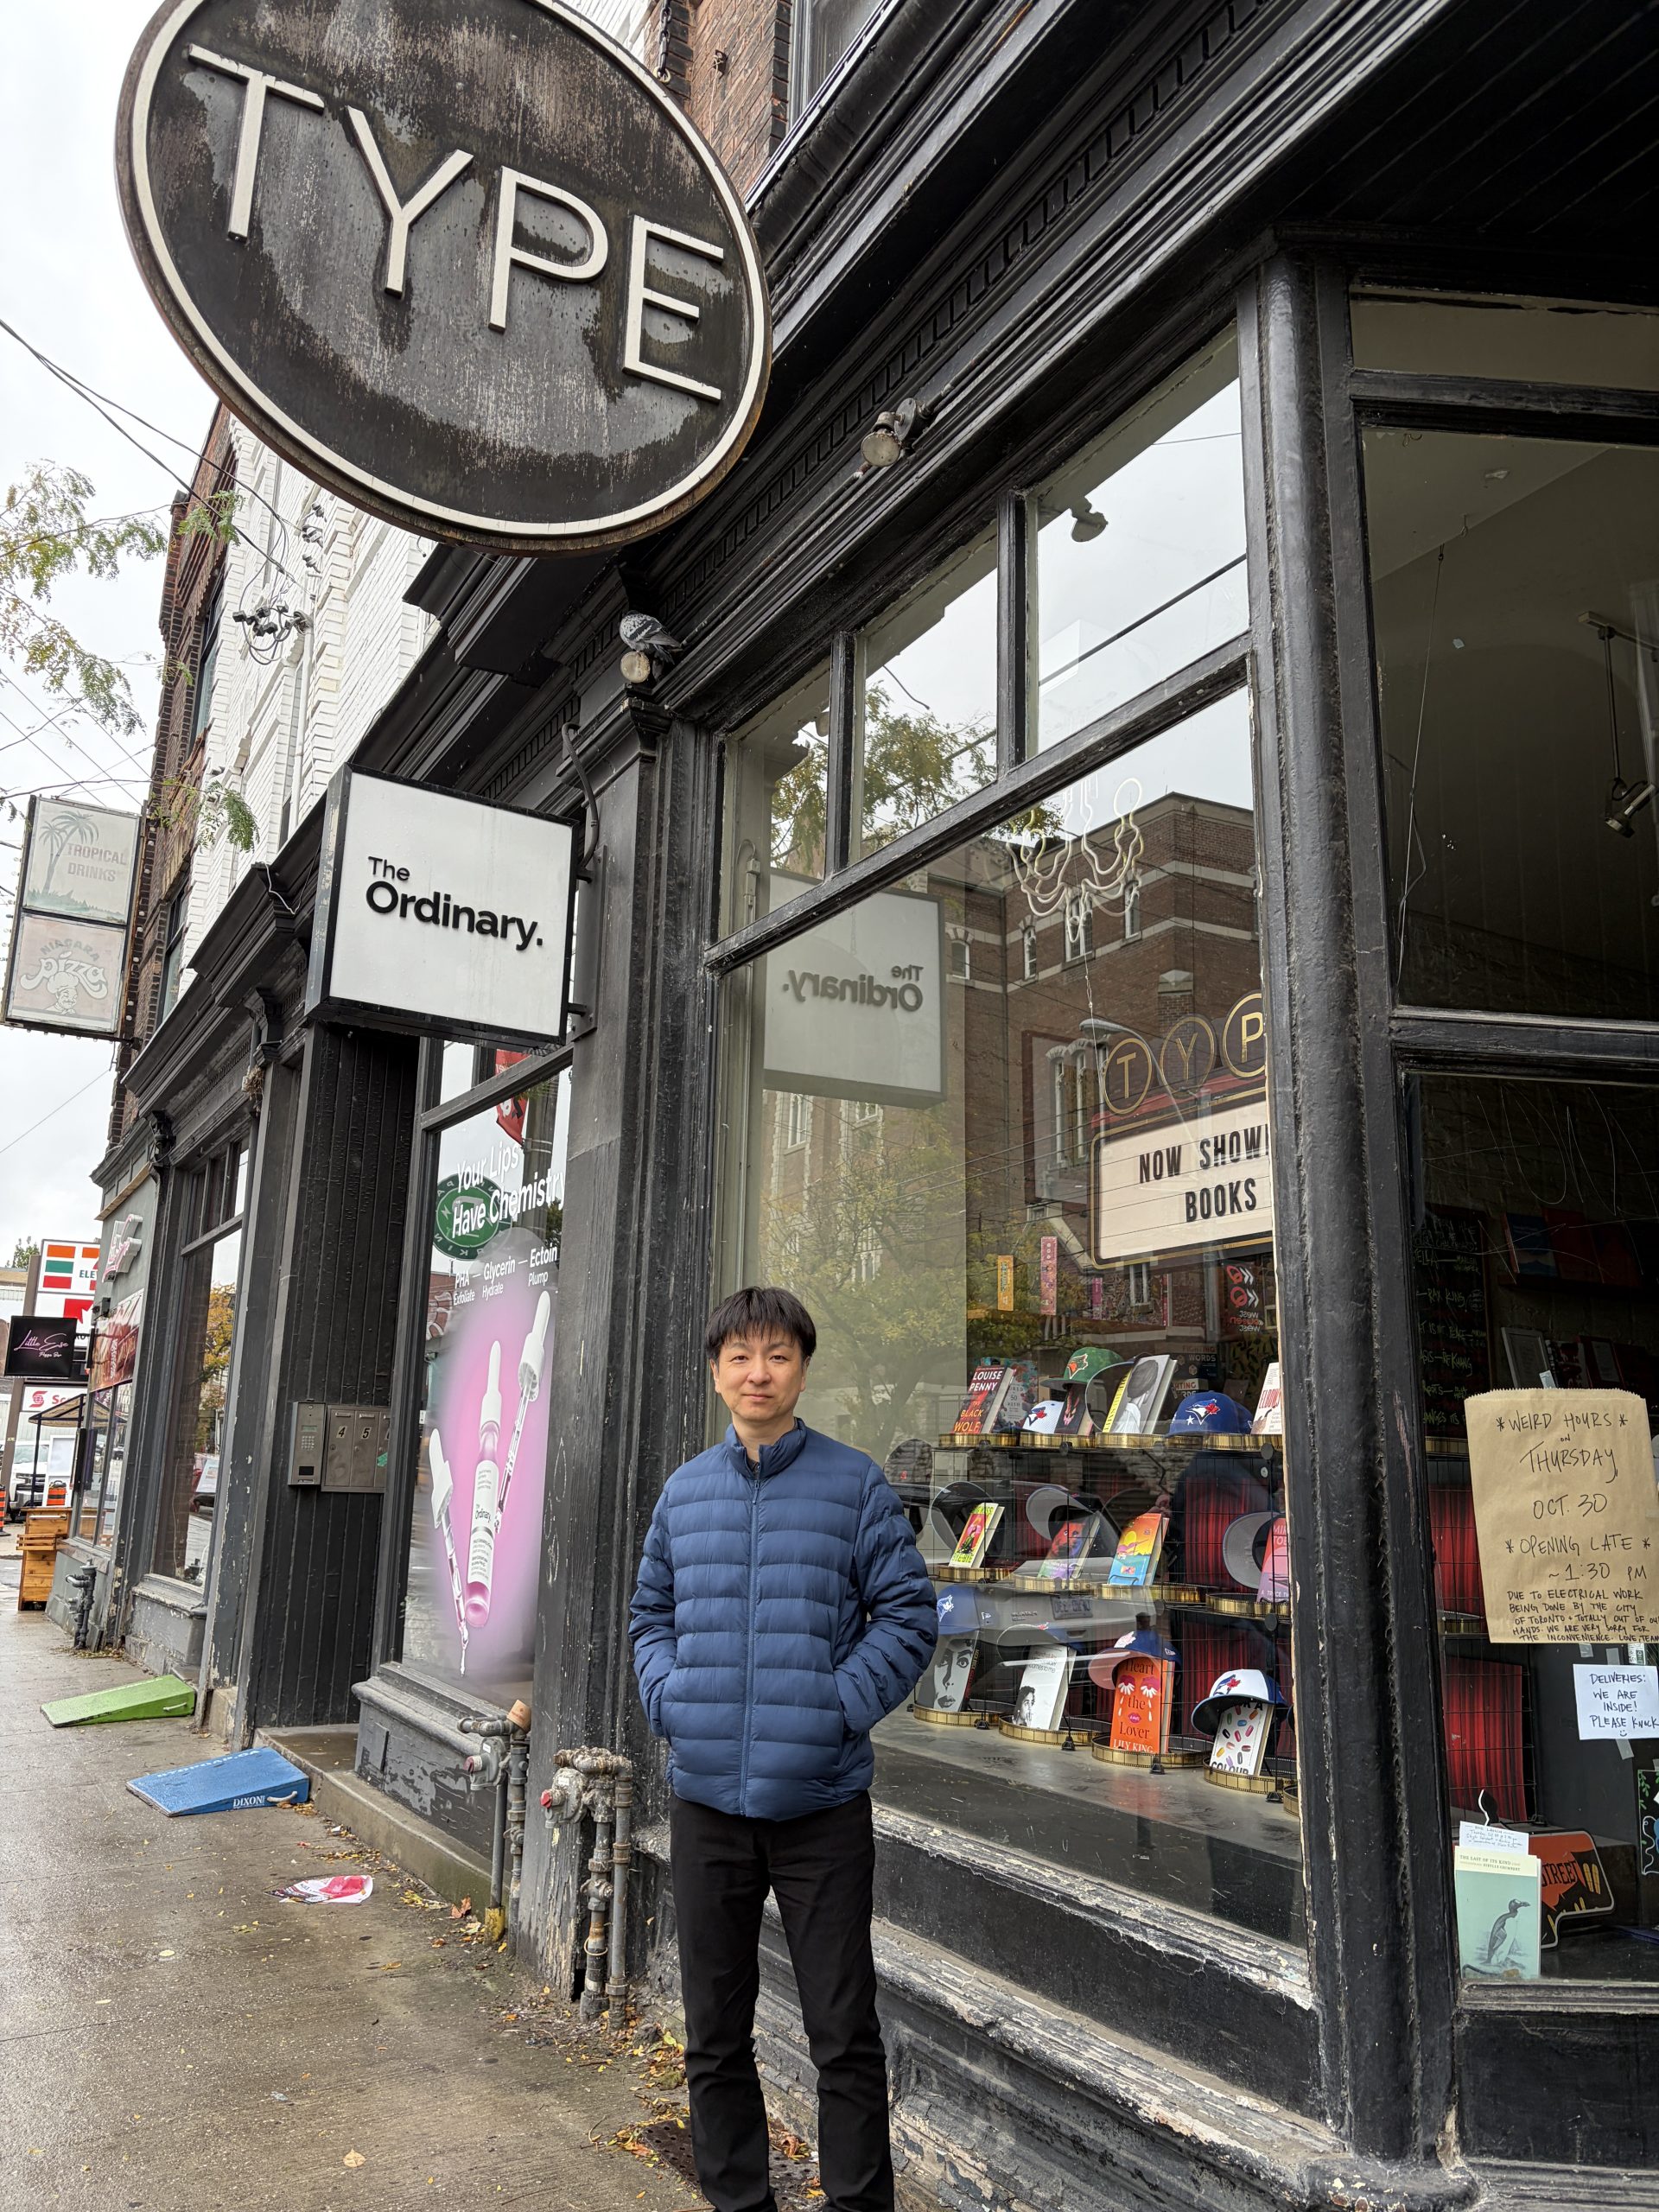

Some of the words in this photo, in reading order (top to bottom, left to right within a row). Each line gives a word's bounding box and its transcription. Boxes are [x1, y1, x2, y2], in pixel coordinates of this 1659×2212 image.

[187, 43, 725, 404] TYPE
[67, 843, 127, 866] TROPICAL
[67, 862, 116, 882] DRINKS
[368, 856, 410, 881] The
[366, 880, 543, 951] Ordinary.
[40, 938, 100, 962] NIAGARA
[456, 1157, 487, 1193] Your
[490, 1140, 520, 1182] Lips
[1139, 1145, 1182, 1184] NOW
[453, 1202, 486, 1238] Have
[489, 1168, 566, 1223] Chemistry
[1185, 1178, 1256, 1222] BOOKS
[79, 1270, 95, 1279] ELE
[454, 1270, 470, 1289] PHA
[484, 1256, 515, 1282] Glycerin
[530, 1243, 557, 1268] Ectoin
[529, 1271, 548, 1287] Plump
[482, 1282, 503, 1300] Hydrate
[14, 1329, 40, 1351] Little
[973, 1370, 1002, 1381] LOUISE
[969, 1382, 997, 1391] PENNY
[954, 1421, 982, 1432] WOLF
[1509, 1410, 1552, 1432] WEIRD
[1564, 1412, 1612, 1432] HOURS
[339, 1427, 346, 1437] 4
[363, 1428, 370, 1438] 5
[1519, 1441, 1618, 1483] THURSDAY
[1533, 1495, 1569, 1519] OCT.
[1578, 1493, 1607, 1517] 30
[1520, 1535, 1580, 1557] OPENING
[1591, 1535, 1633, 1551] LATE
[1627, 1566, 1647, 1581] PM
[1507, 1591, 1524, 1600] DUE
[1529, 1591, 1541, 1599] TO
[1548, 1589, 1609, 1600] ELECTRICAL
[1613, 1587, 1643, 1600] WORK
[1509, 1602, 1538, 1613] BEING
[1542, 1602, 1566, 1611] DONE
[1573, 1602, 1585, 1614] BY
[1590, 1602, 1607, 1612] THE
[1616, 1604, 1637, 1618] CITY
[1529, 1614, 1565, 1624] TORONTO
[1574, 1614, 1607, 1627] TOTALLY
[1564, 1624, 1580, 1633] ARE
[1581, 1624, 1600, 1635] VERY
[1606, 1624, 1627, 1635] SORRY
[1125, 1658, 1154, 1675] Heart
[1128, 1695, 1146, 1709] the
[1593, 1688, 1609, 1700] WE
[1618, 1690, 1637, 1700] ARE
[1604, 1700, 1637, 1713] INSIDE!
[1120, 1721, 1149, 1738] Lover
[1590, 1715, 1626, 1728] PLEASE
[1113, 1738, 1132, 1750] LILY
[1133, 1740, 1153, 1752] KING
[1211, 1761, 1249, 1775] COLOUR
[233, 1796, 263, 1807] DIXON
